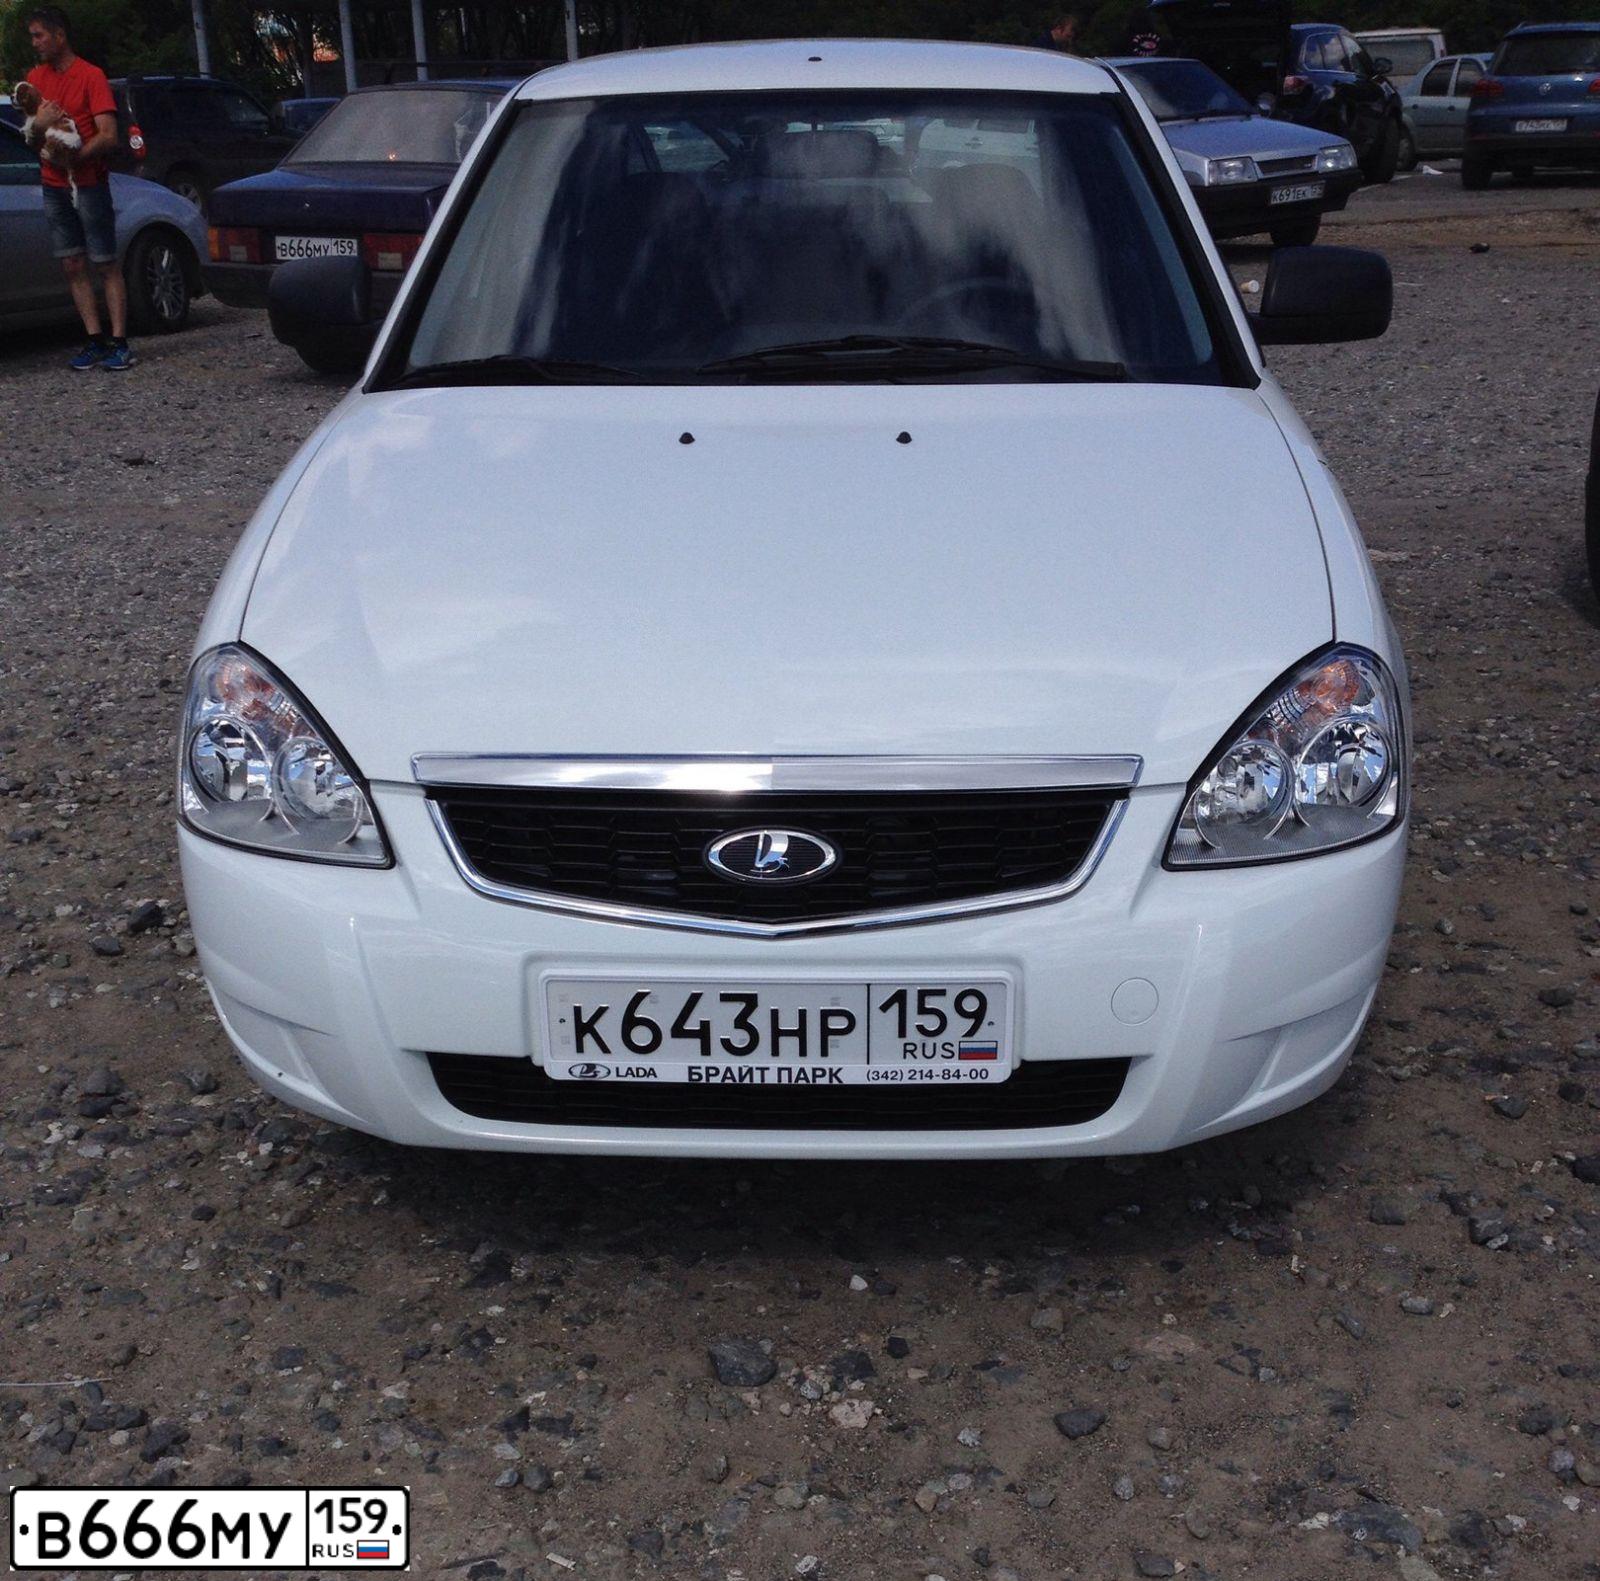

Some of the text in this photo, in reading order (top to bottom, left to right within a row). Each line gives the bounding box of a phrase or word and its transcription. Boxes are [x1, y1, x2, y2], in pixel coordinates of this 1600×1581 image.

[280, 239, 354, 258] В666МУ 159
[573, 988, 988, 1058] К643НР 159
[903, 1041, 957, 1060] RUS
[615, 1066, 658, 1079] LADA
[687, 1064, 844, 1084] БРАЙТ ПАРК
[866, 1067, 990, 1082] (342) 214-84-00
